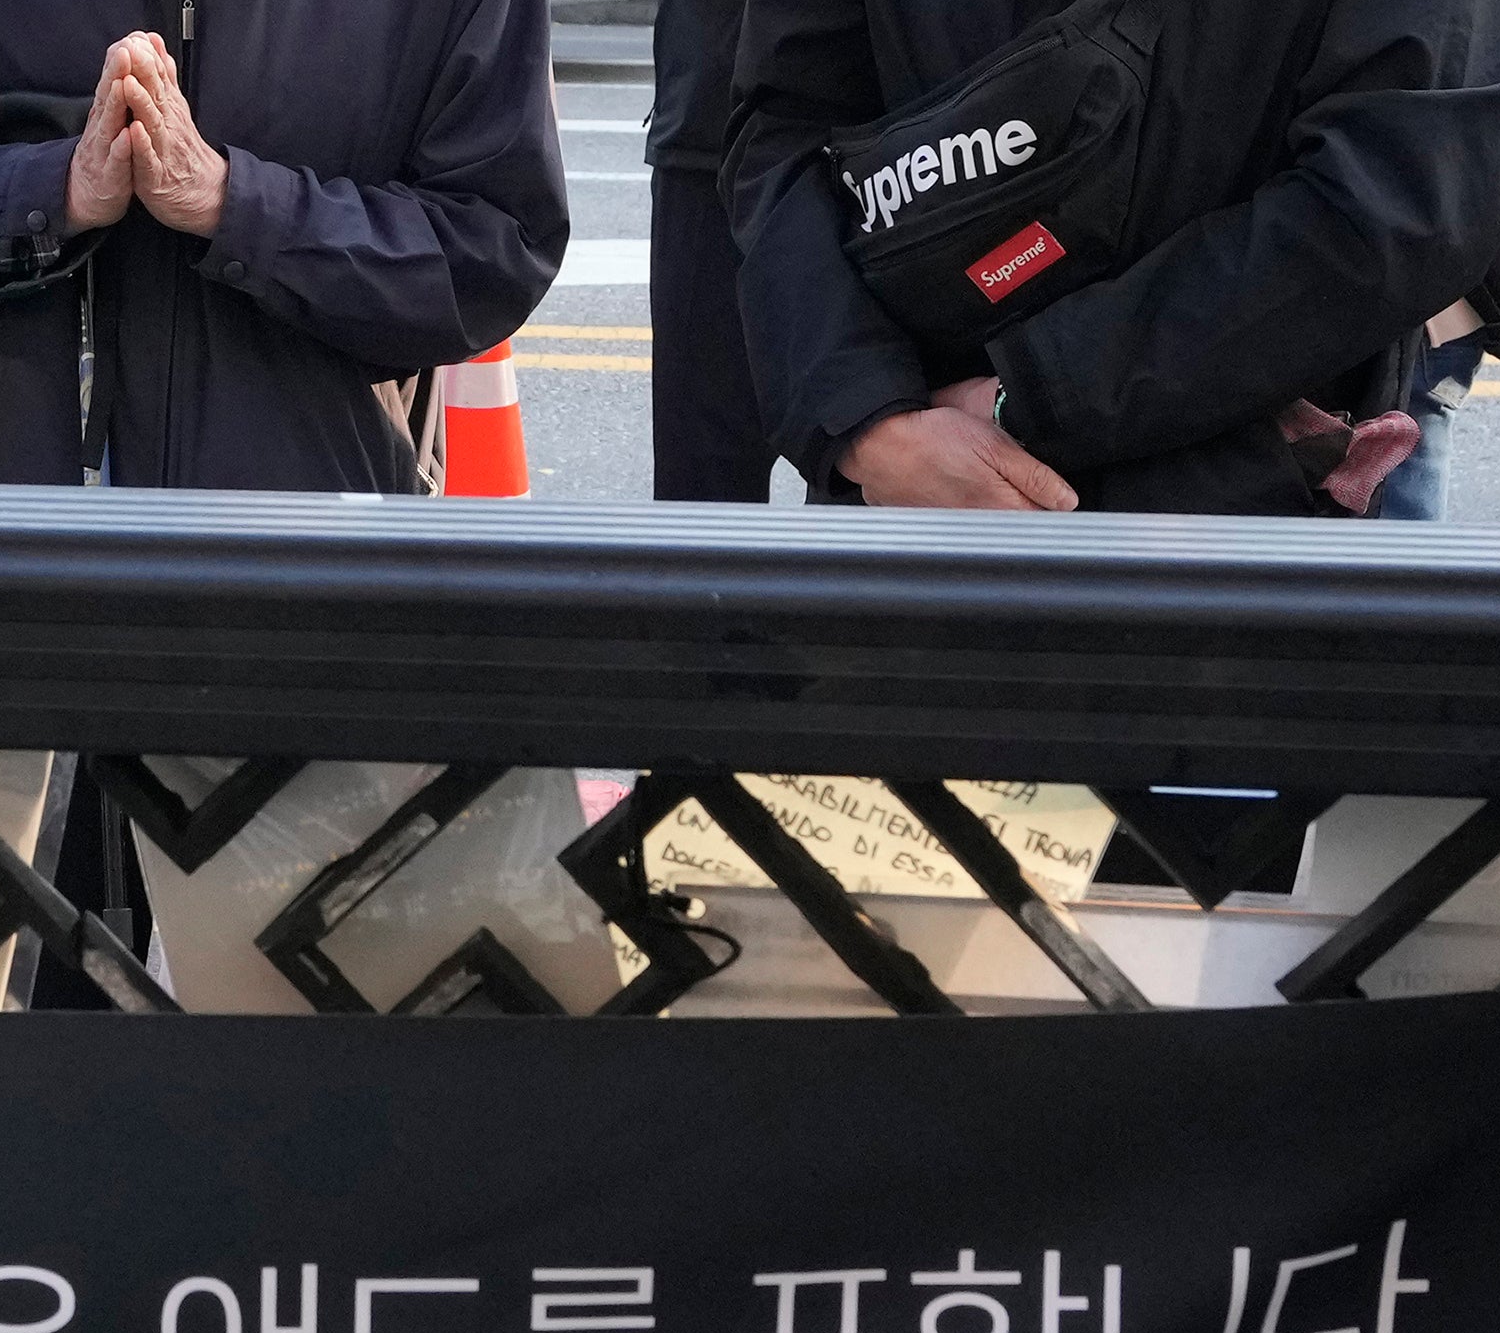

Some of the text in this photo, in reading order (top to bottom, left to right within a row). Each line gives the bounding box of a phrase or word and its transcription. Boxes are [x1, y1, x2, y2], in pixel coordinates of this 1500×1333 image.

[852, 833, 880, 862] DI
[897, 850, 955, 890] ESSA
[1022, 825, 1094, 874] TROVA
